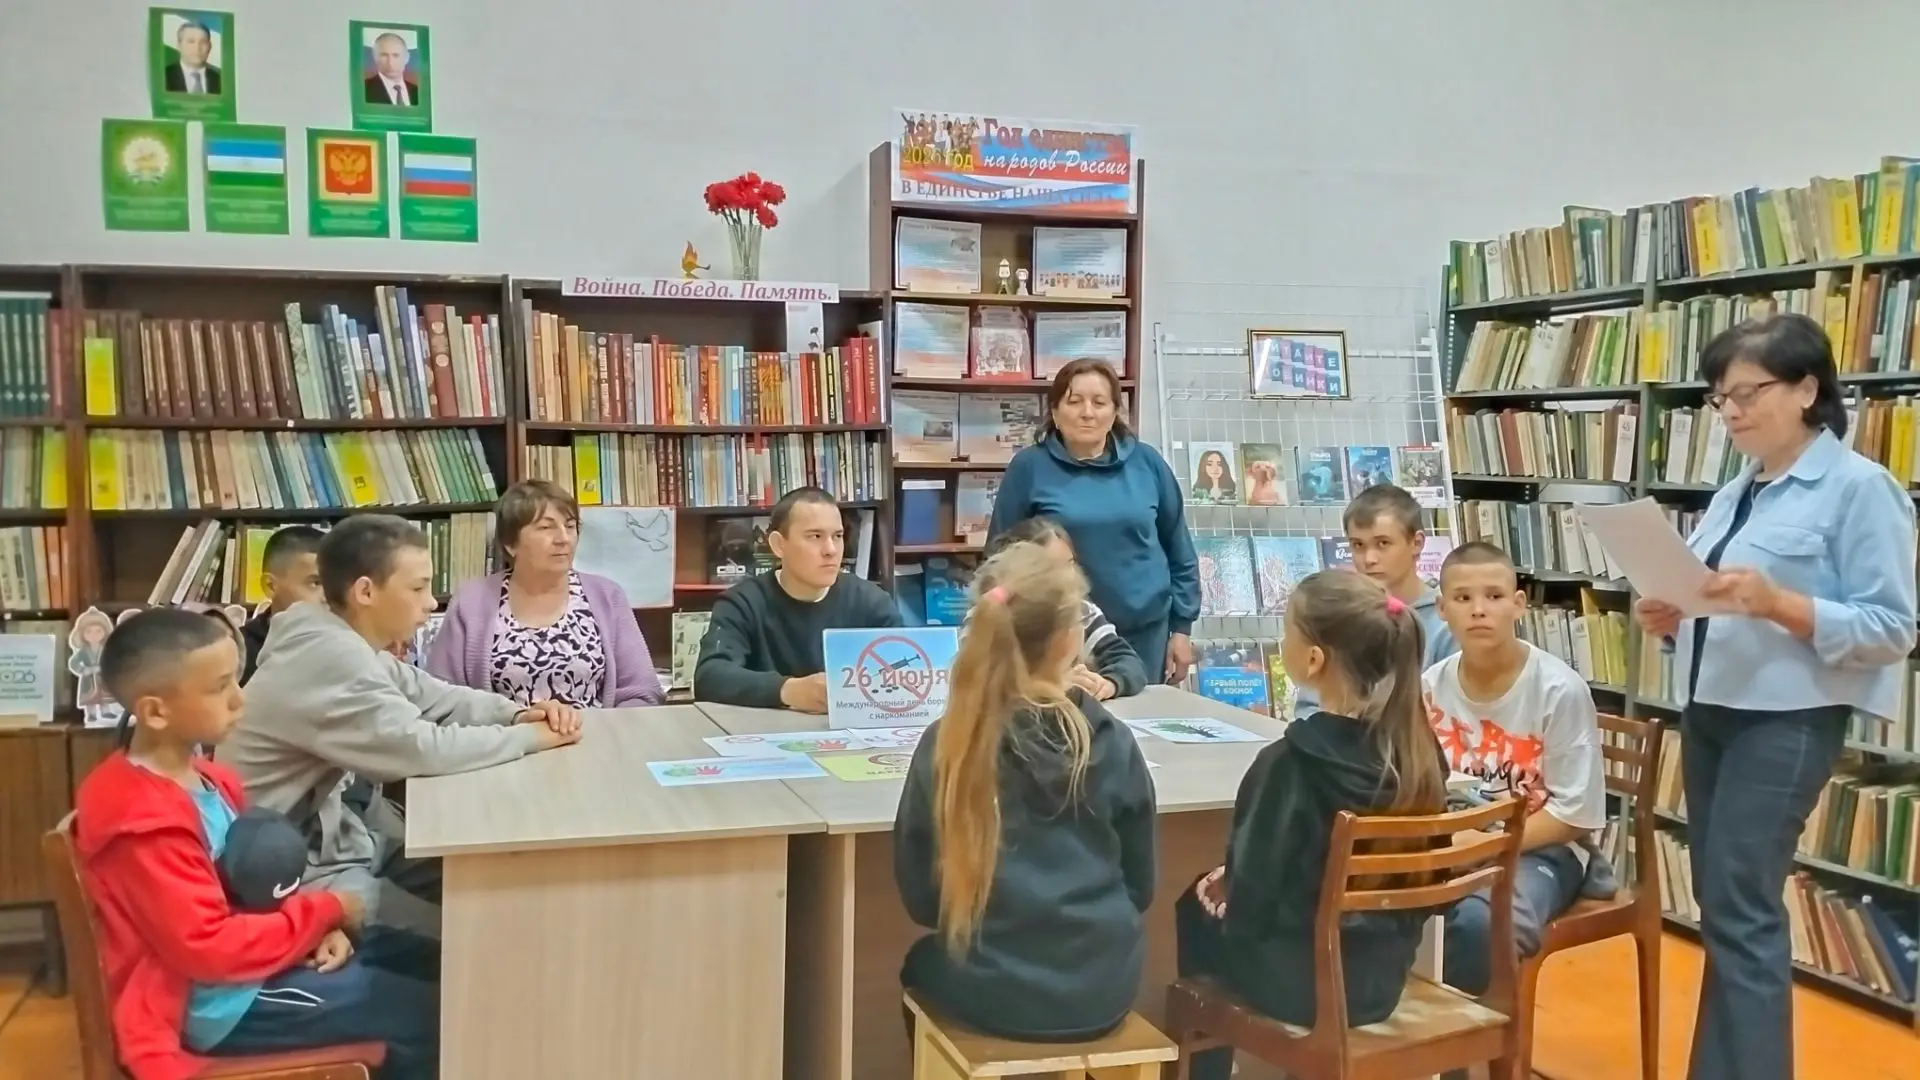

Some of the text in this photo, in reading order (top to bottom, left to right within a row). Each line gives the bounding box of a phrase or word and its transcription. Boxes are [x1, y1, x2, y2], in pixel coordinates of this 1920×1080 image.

[983, 118, 1023, 149] Год
[983, 149, 1128, 176] народов России
[901, 180, 912, 194] В
[573, 277, 832, 300] Война. Победа. Память.
[841, 666, 872, 688] 26
[836, 699, 905, 709] Международный
[875, 711, 929, 720] наркоманией
